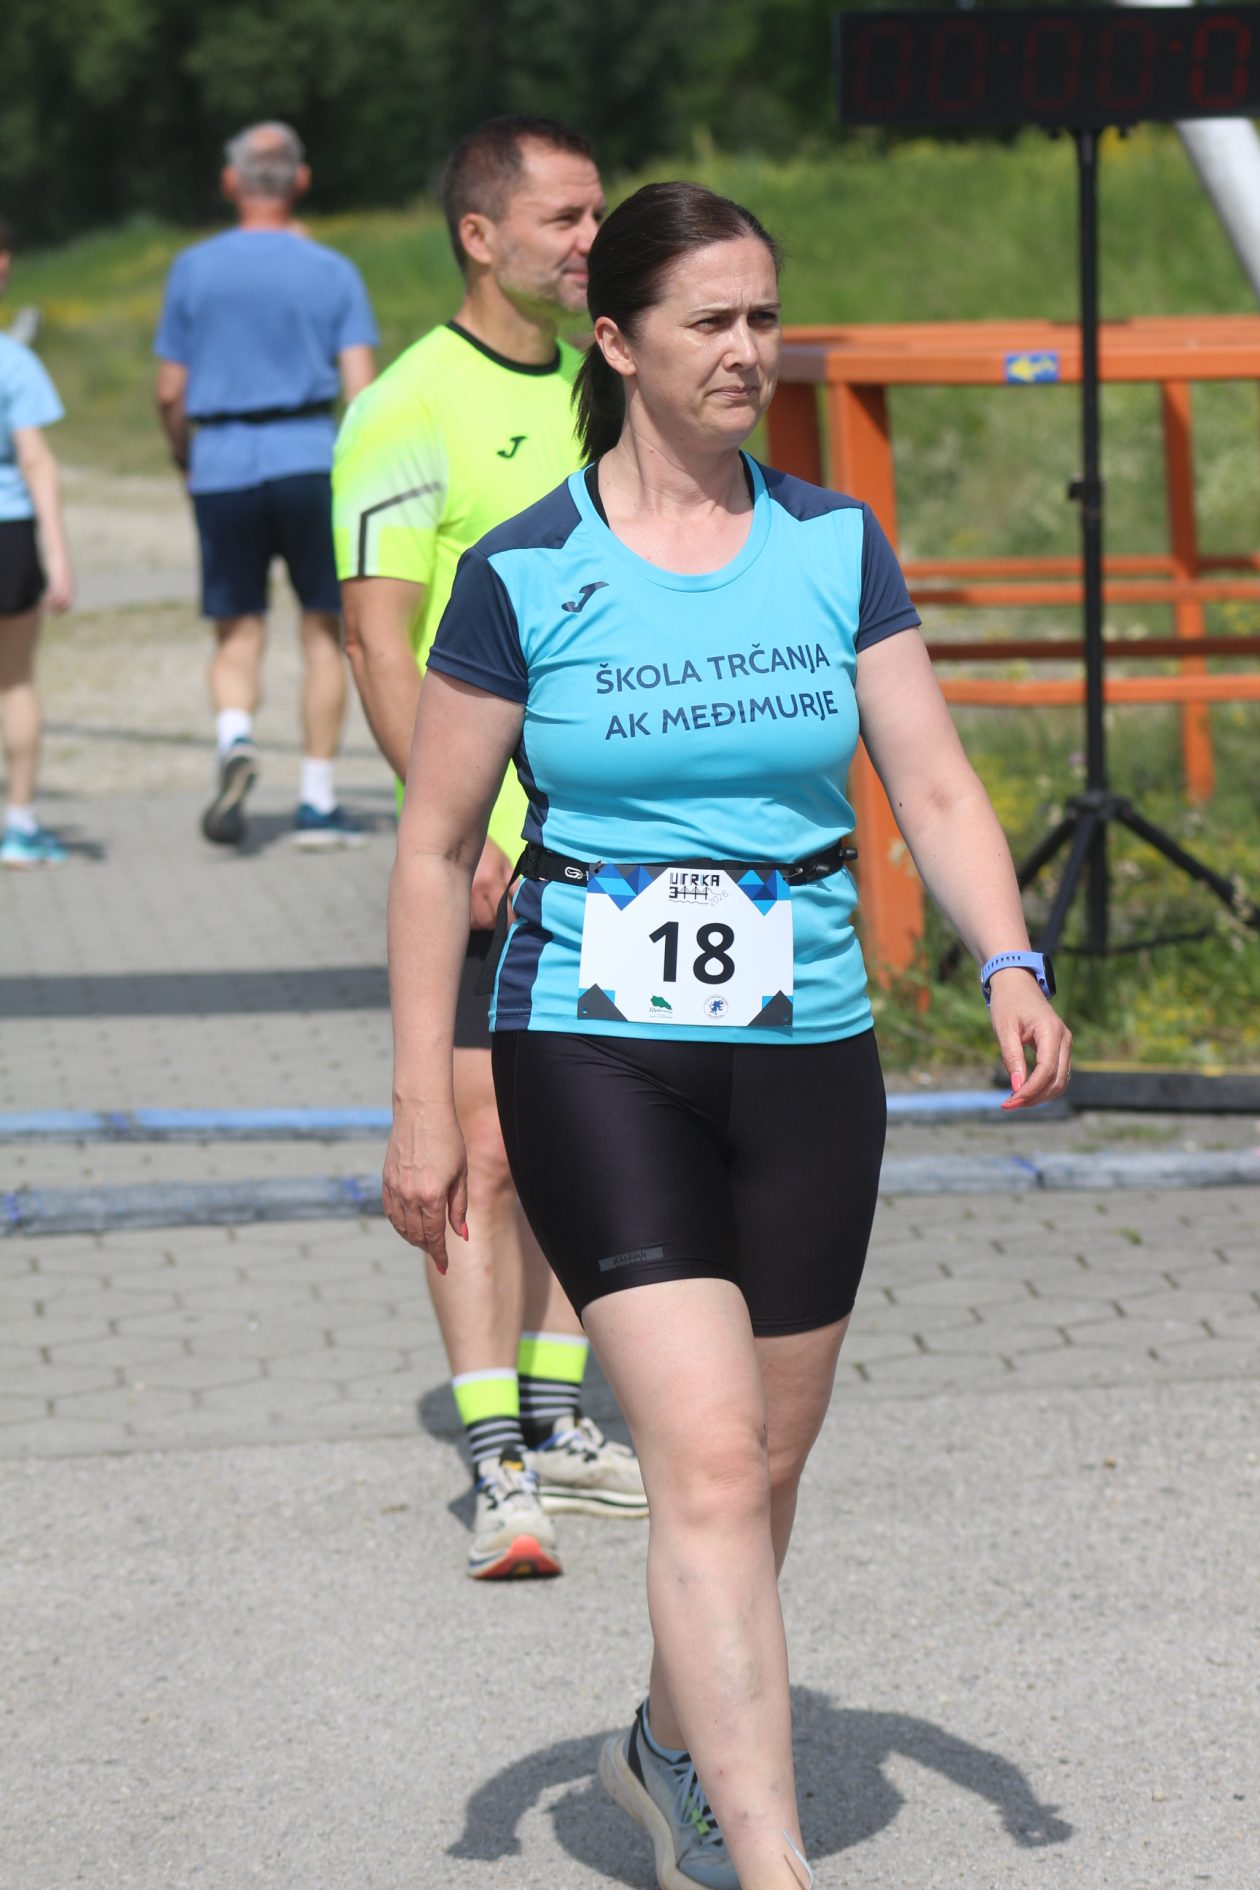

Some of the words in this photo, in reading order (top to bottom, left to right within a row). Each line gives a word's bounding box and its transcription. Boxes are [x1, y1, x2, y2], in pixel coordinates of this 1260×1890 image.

[596, 663, 703, 694] ŠKOLA
[707, 643, 831, 680] TRČANJA
[605, 712, 651, 740] AK
[662, 690, 838, 734] MEĐIMURJE
[648, 921, 735, 985] 18
